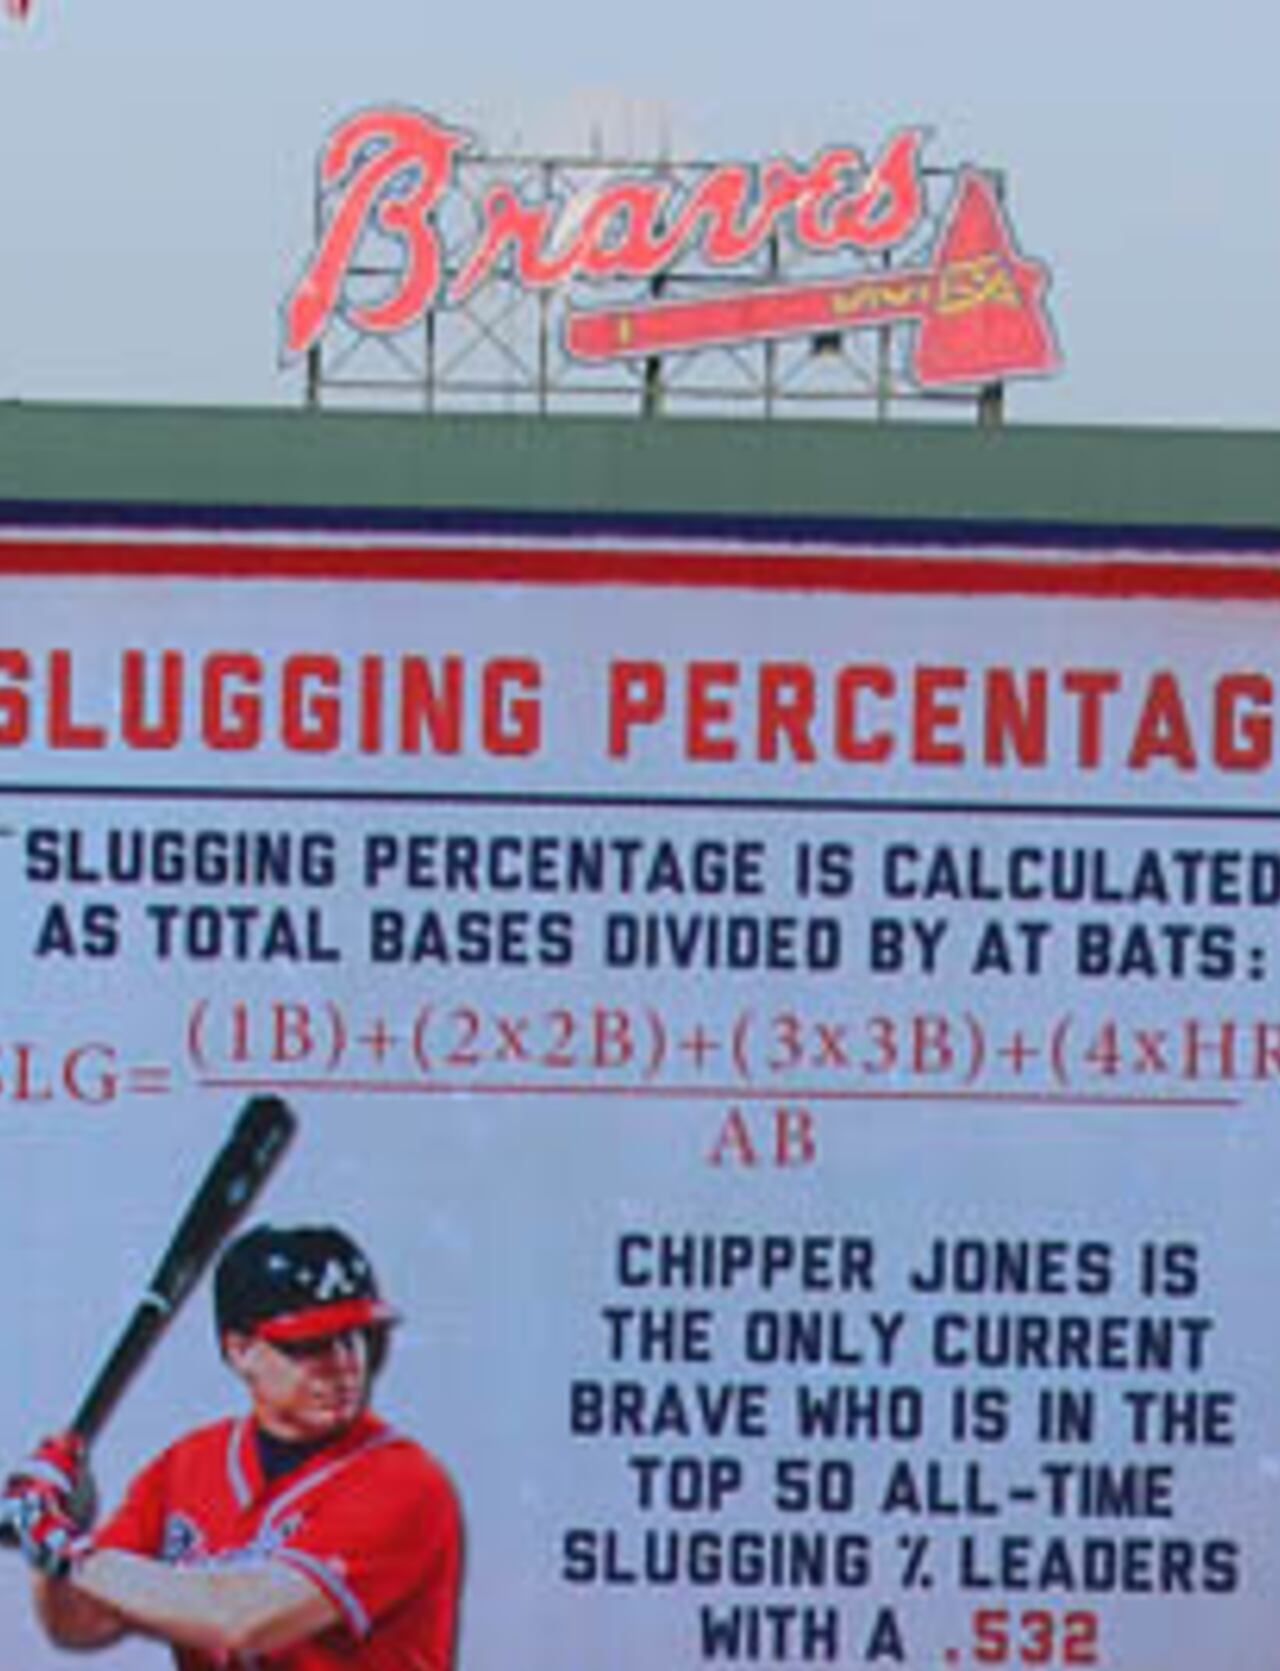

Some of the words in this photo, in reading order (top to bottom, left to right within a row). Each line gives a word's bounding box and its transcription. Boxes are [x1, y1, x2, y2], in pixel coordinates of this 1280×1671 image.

[280, 107, 936, 366] Braves
[25, 828, 337, 887] SLUGGING
[365, 836, 766, 896] PERCENTAGE
[795, 842, 854, 898] IS
[34, 903, 120, 959] AS
[146, 905, 342, 963] TOTAL
[370, 910, 574, 965] BASES
[605, 912, 842, 972] DIVIDED
[870, 918, 948, 975] BY
[970, 920, 1052, 977] AT
[1076, 923, 1266, 981] BATS:
[707, 1105, 817, 1169] AB
[618, 1233, 876, 1293] CHIPPER
[910, 1238, 1114, 1297] JONES
[1140, 1241, 1200, 1299] IS
[601, 1308, 712, 1364] THE
[744, 1310, 906, 1367] ONLY
[931, 1315, 1214, 1372] CURRENT
[568, 1380, 768, 1438] BRAVE
[796, 1384, 924, 1442] WHO
[951, 1386, 1010, 1445] IS
[1037, 1388, 1096, 1445] IN
[1122, 1390, 1237, 1447] THE
[628, 1454, 743, 1513] TOP
[775, 1458, 855, 1514] 50
[880, 1460, 1176, 1520] ALL-TIME
[562, 1528, 872, 1588] SLUGGING
[897, 1533, 934, 1590] %
[958, 1536, 1242, 1595] LEADERS
[699, 1605, 840, 1663] WITH
[865, 1606, 907, 1663] A
[944, 1608, 1100, 1668] .532
